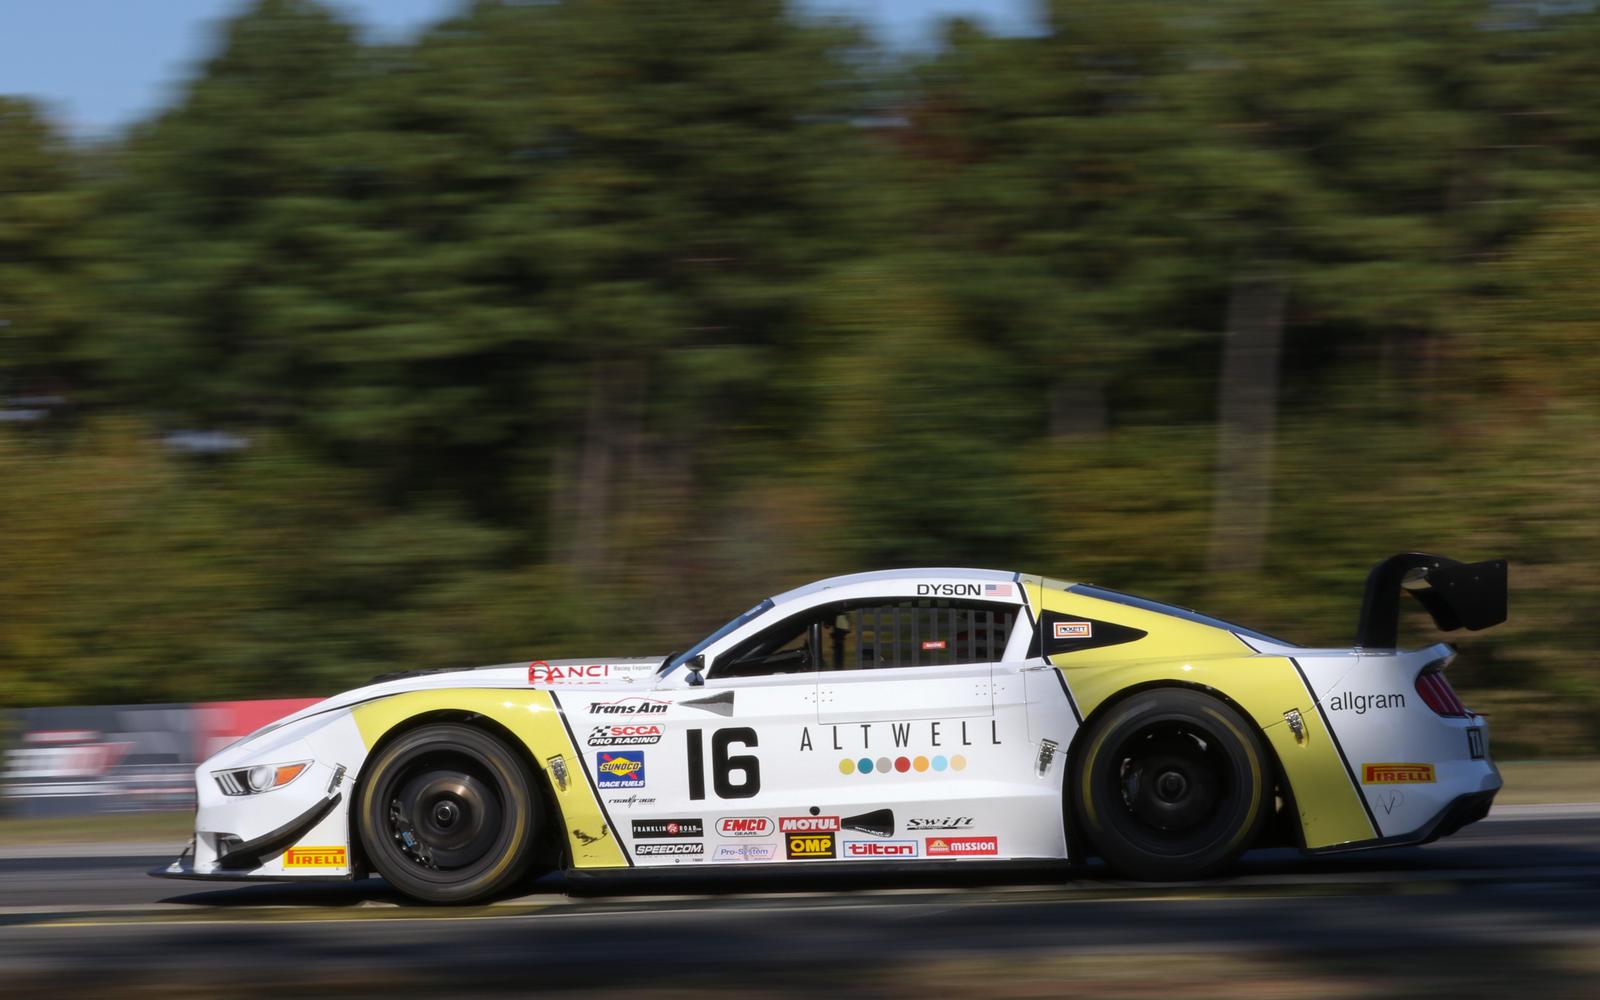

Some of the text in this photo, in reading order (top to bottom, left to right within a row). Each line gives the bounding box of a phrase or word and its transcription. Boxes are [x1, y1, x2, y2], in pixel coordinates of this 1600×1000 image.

[917, 584, 981, 596] DYSON
[590, 702, 668, 714] Trans Am
[1330, 691, 1406, 715] allgram
[611, 726, 660, 736] SCCA
[800, 720, 1002, 751] ALTWELL
[686, 727, 761, 800] 16
[1366, 765, 1431, 782] PIRELLI
[633, 825, 667, 833] FRANKLIN
[723, 819, 767, 831] EMCO
[782, 818, 838, 830] MOTUL
[790, 838, 832, 853] OMP
[848, 843, 914, 855] tilton
[287, 849, 345, 865] PIRELLI
[720, 848, 769, 857] Pro-System
